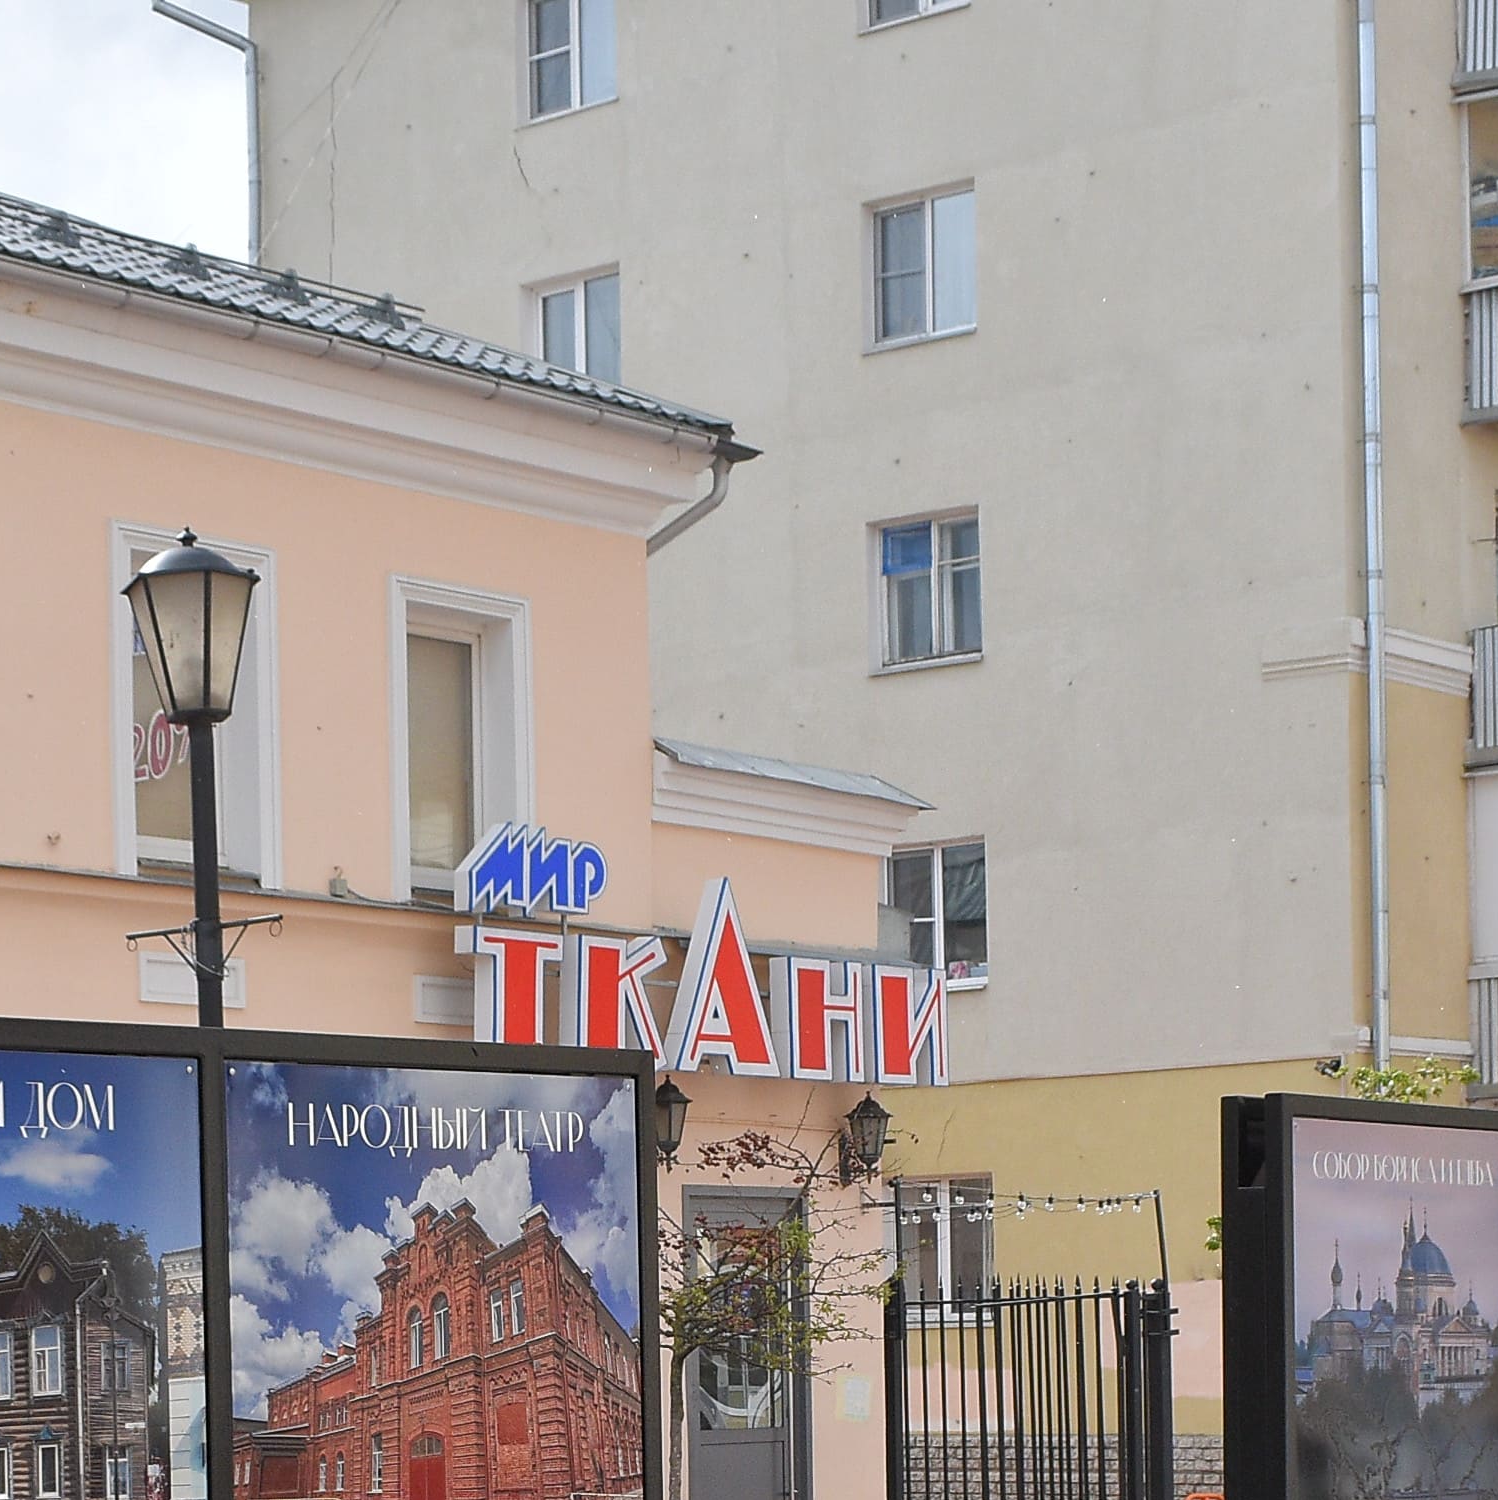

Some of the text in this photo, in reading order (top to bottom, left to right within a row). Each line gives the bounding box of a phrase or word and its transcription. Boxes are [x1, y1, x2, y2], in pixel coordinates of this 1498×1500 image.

[454, 822, 607, 916] МИР
[455, 877, 949, 1087] ТКАНИ
[20, 1081, 118, 1140] ДОМ
[286, 1100, 586, 1159] НАРОДНЫЙ ТЕАТР
[1312, 1150, 1369, 1181] СОБОР
[1374, 1154, 1437, 1184] БОРИСА
